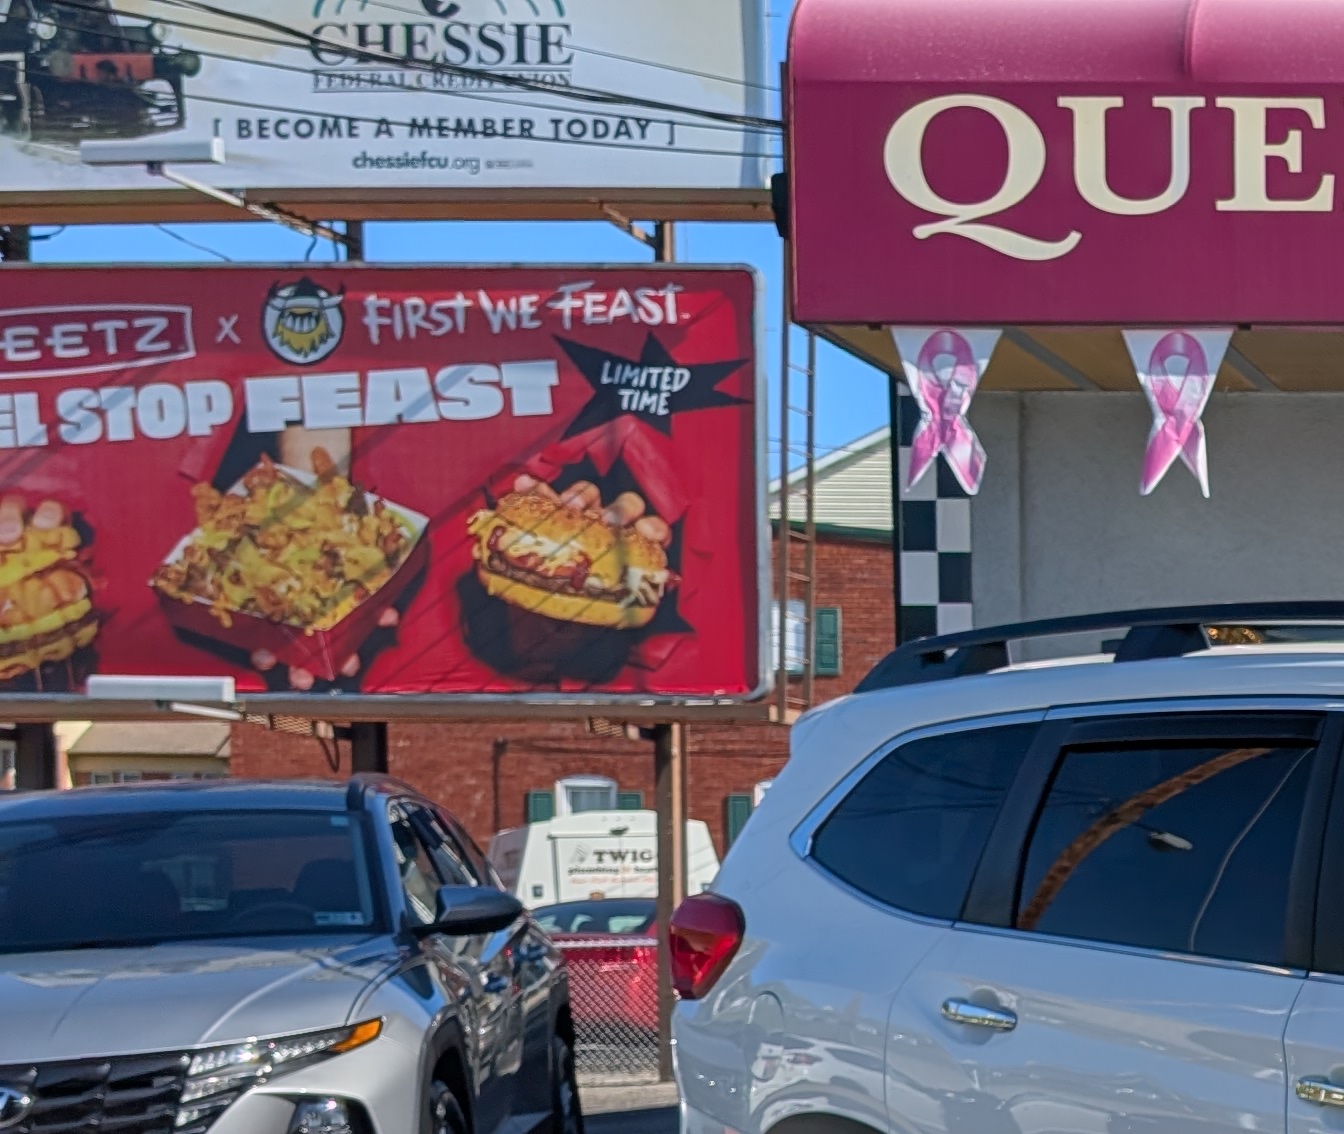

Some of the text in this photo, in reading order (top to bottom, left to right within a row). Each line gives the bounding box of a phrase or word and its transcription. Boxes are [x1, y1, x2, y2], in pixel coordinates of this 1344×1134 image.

[309, 23, 574, 66] CHESSIE
[236, 117, 652, 140] BECOME A MEMBER TODAY
[352, 150, 481, 176] chessiefcu.org
[363, 280, 684, 345] FIRST WE FEAST
[600, 360, 692, 393] LIMITED
[56, 380, 234, 444] STOP
[245, 360, 560, 433] FEAST
[616, 388, 673, 417] TIME
